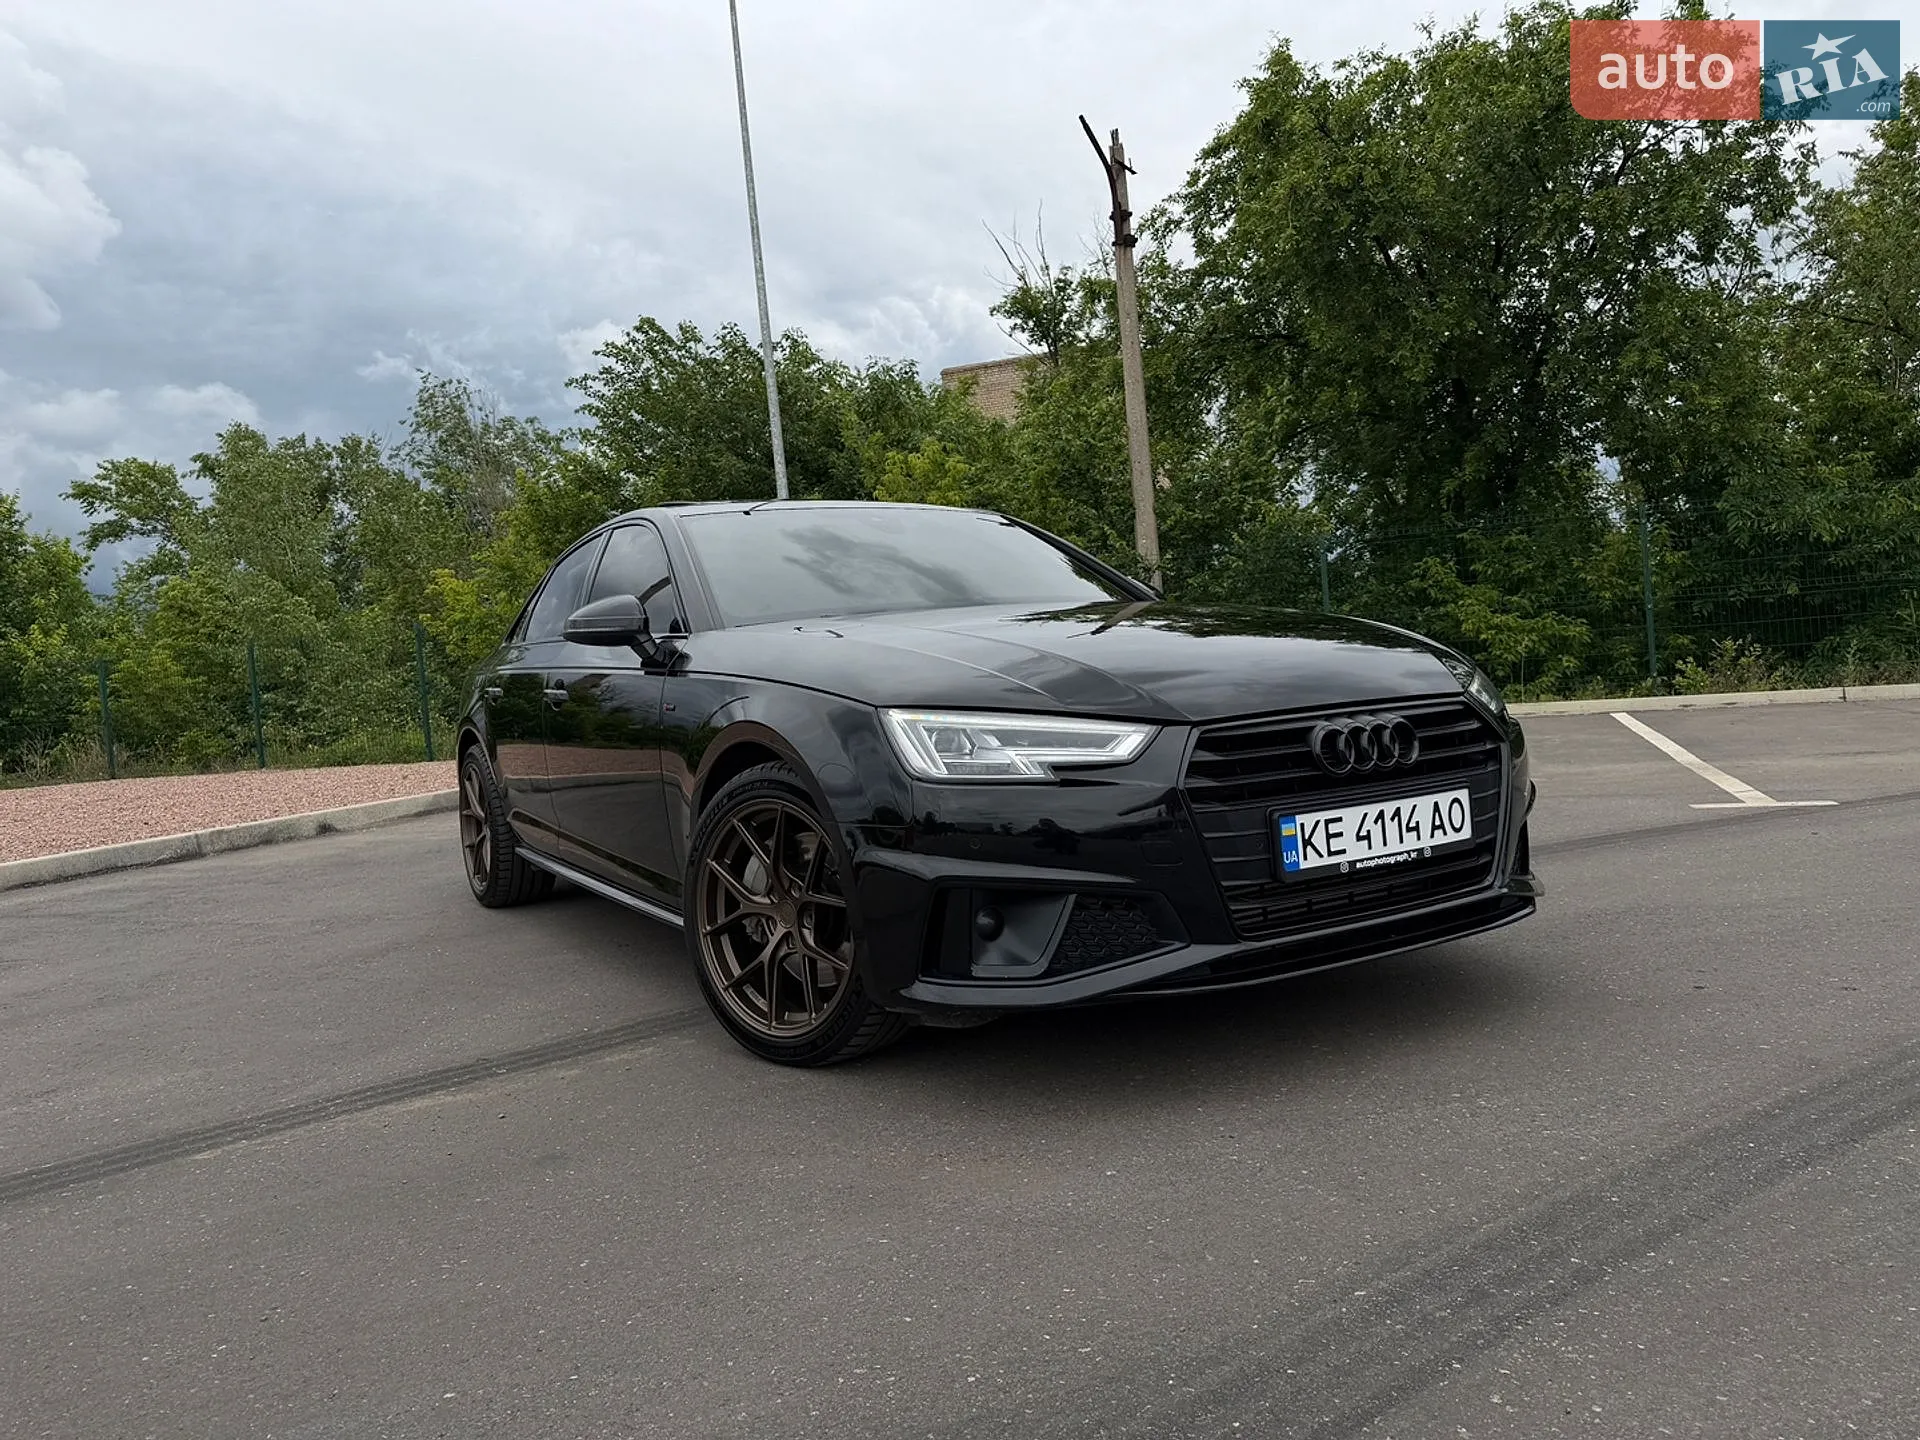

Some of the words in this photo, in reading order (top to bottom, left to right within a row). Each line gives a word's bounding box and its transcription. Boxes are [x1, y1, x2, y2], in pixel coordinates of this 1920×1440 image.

[1300, 816, 1347, 861] KE
[1355, 804, 1421, 850] 4114
[1430, 797, 1465, 839] AO
[1283, 850, 1298, 863] UA
